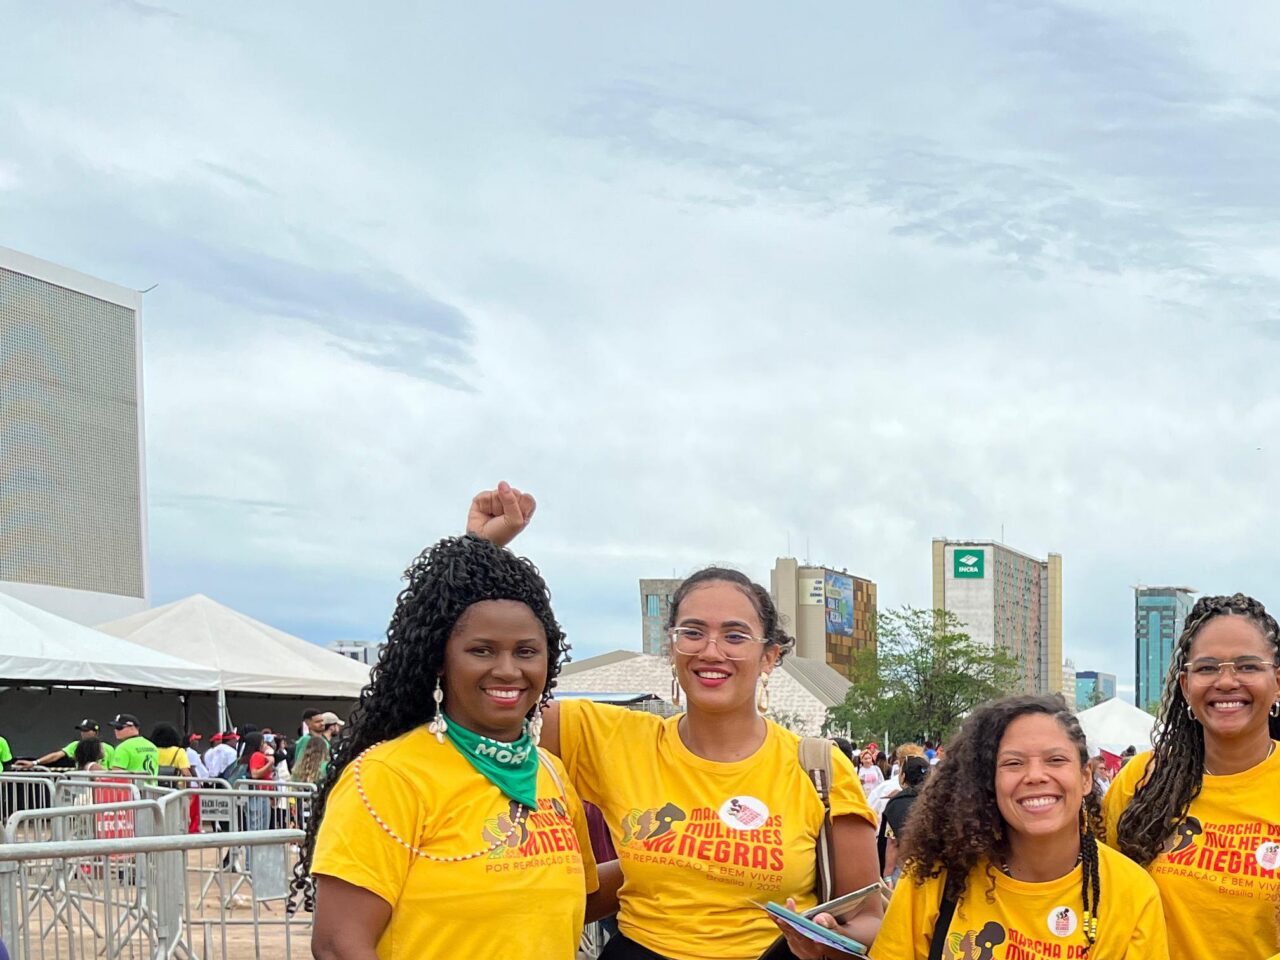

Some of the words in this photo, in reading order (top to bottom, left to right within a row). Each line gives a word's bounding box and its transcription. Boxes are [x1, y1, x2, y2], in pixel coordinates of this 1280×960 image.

[1204, 822, 1262, 835] MARCHA
[677, 835, 784, 872] NEGRAS
[486, 862, 509, 873] POR
[720, 866, 745, 878] BEM
[750, 872, 783, 883] VIVER
[756, 882, 781, 892] 2025
[1231, 877, 1254, 888] BEM
[1008, 927, 1062, 959] MARCHA
